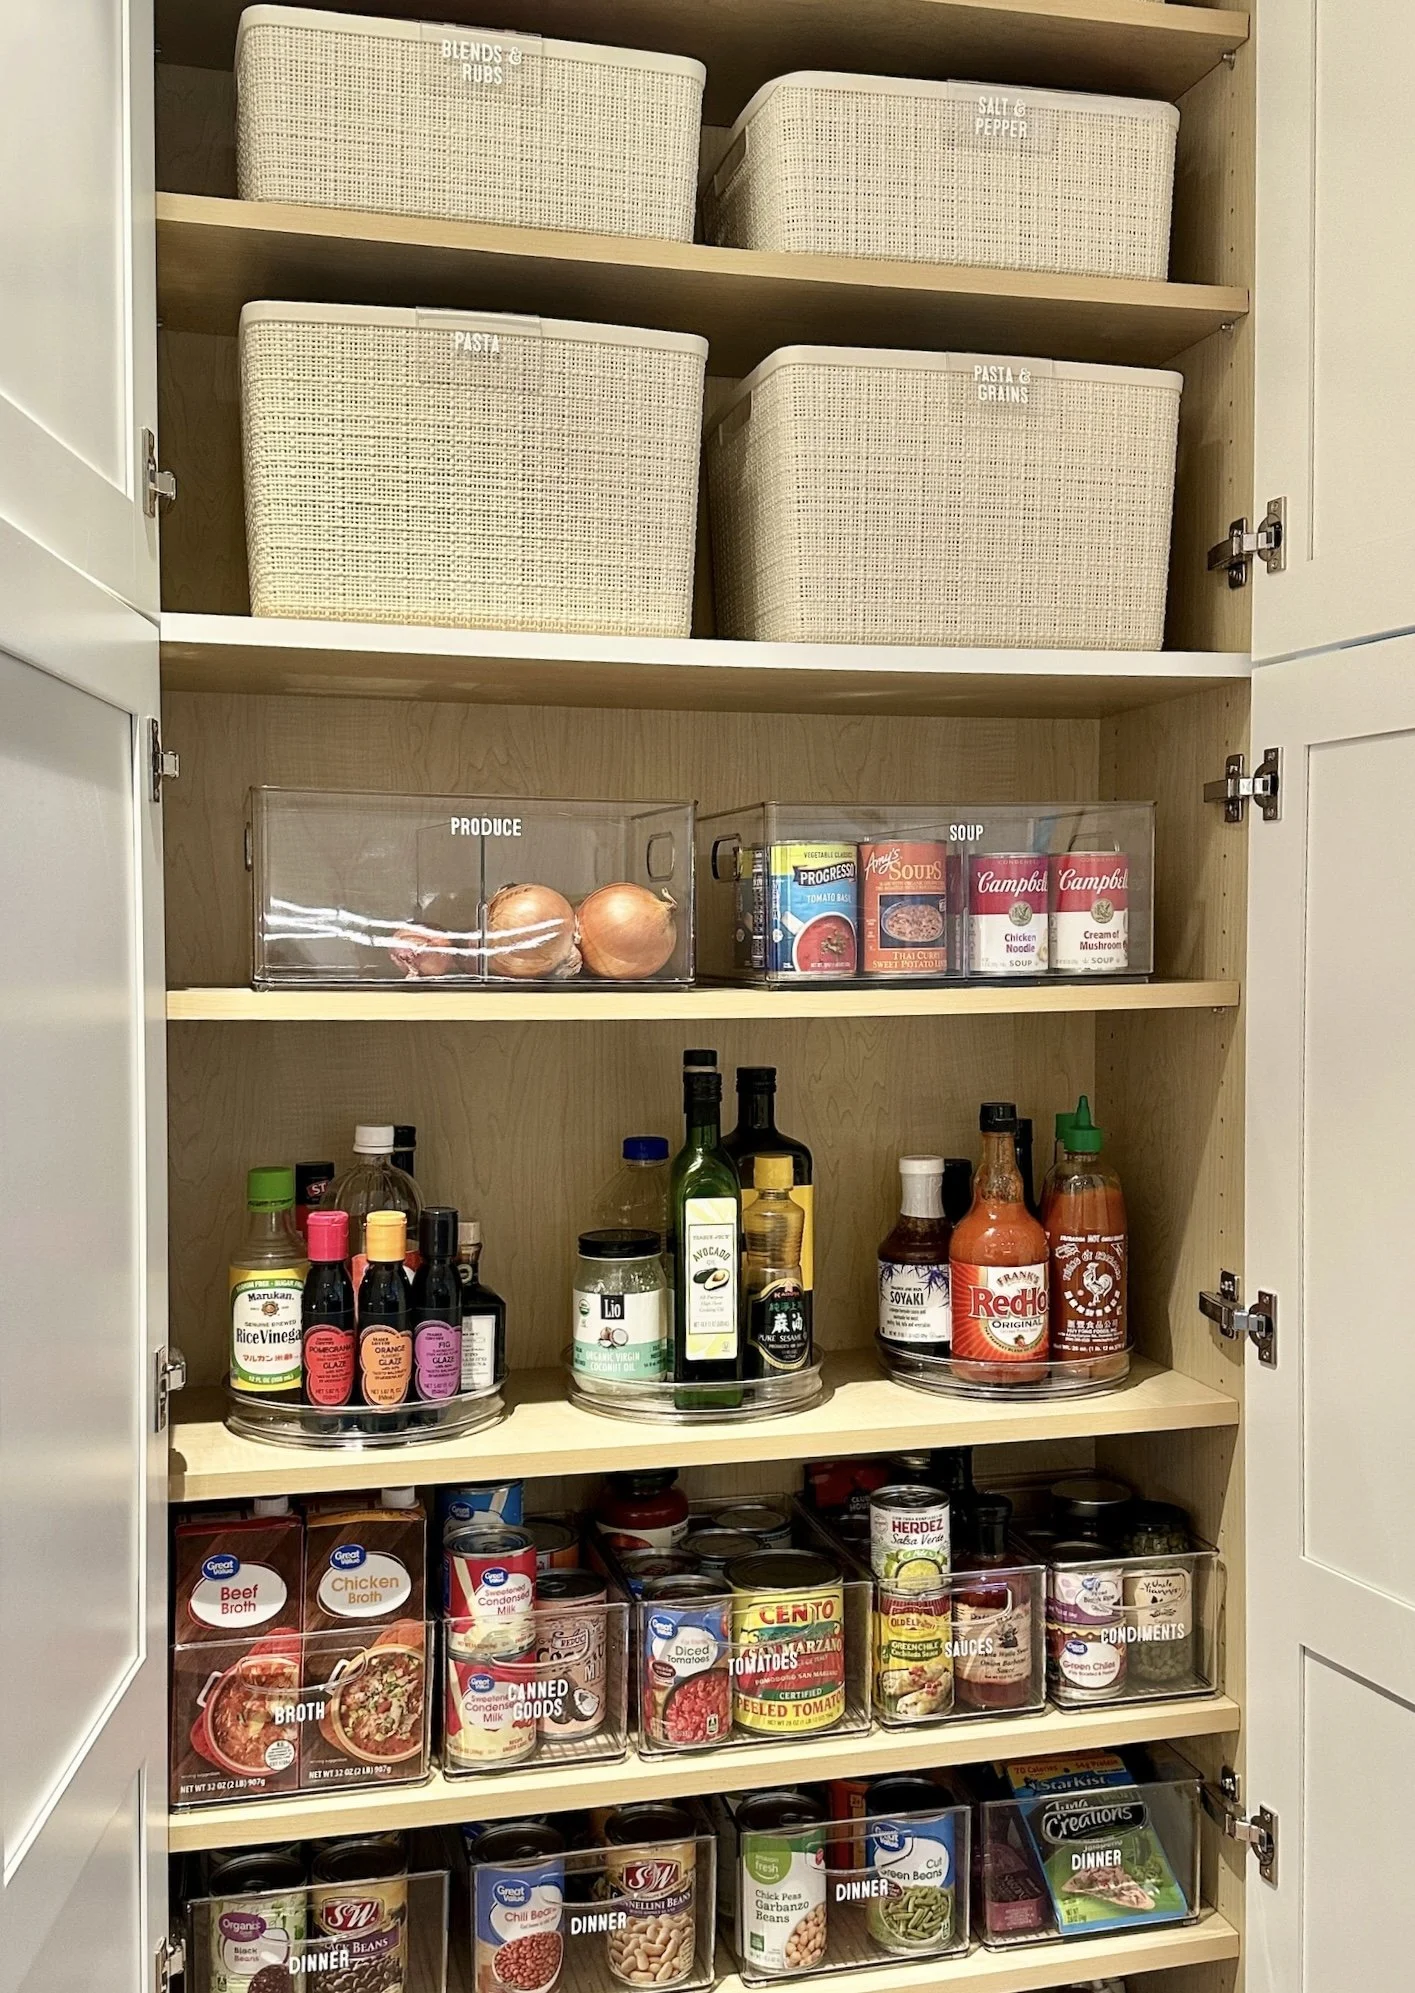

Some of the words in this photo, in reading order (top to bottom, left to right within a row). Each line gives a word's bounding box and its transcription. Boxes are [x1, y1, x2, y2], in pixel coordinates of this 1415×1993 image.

[442, 40, 503, 64] BLENDS
[509, 46, 522, 65] &
[462, 63, 503, 85] RUBS
[979, 96, 1008, 116] SALT
[1013, 98, 1027, 117] &
[975, 117, 1028, 138] PEPPER
[455, 331, 500, 353] PASTA
[974, 364, 1014, 383] PASTA
[1018, 367, 1031, 384] &
[977, 384, 1030, 404] GRAINS
[450, 817, 522, 837] PRODUCE
[949, 824, 984, 842] SOUP
[803, 851, 834, 859] VEGETABLE
[864, 848, 903, 881] Amy's
[888, 861, 943, 881] SOUPS
[800, 863, 856, 885] PROGRESSO
[806, 893, 836, 904] TOMATO
[1004, 932, 1037, 944] Chicken
[1083, 930, 1111, 943] Cream
[1112, 930, 1120, 941] of
[1005, 943, 1036, 954] Noodle
[1080, 941, 1122, 951] Mushroom
[873, 959, 899, 970] SWEET
[901, 958, 932, 969] POTATO
[892, 952, 915, 964] THAI
[1091, 957, 1114, 965] SOUP
[693, 1246, 731, 1262] AVOCADO
[997, 1271, 1040, 1287] FRANK'S
[890, 1291, 924, 1306] SOYAKI
[968, 1284, 1049, 1320] RedHo
[604, 1299, 621, 1318] Lio
[992, 1319, 1043, 1329] ORIGINAL
[236, 1328, 260, 1344] Rice
[375, 1345, 406, 1354] ORANGE
[586, 1351, 613, 1361] ORGANIC
[616, 1350, 641, 1360] VIRGIN
[323, 1360, 346, 1370] GLAZE
[379, 1357, 402, 1366] GLAZE
[433, 1356, 455, 1364] GLAZE
[591, 1361, 621, 1372] COCONUT
[623, 1361, 637, 1371] OIL
[892, 1518, 943, 1534] HERDEZ
[891, 1533, 918, 1545] Salsa
[335, 1550, 360, 1560] Great
[207, 1560, 233, 1571] Great
[331, 1574, 400, 1592] Chicken
[485, 1583, 526, 1597] Sweetened
[220, 1583, 259, 1601] Beef
[348, 1591, 383, 1606] Broth
[478, 1590, 530, 1607] Condensed
[220, 1600, 257, 1615] Broth
[497, 1605, 516, 1615] Milk
[758, 1600, 836, 1626] CENTO
[1101, 1622, 1185, 1644] CONDIMENTS
[675, 1645, 710, 1656] Diced
[782, 1638, 842, 1656] MARZANO
[891, 1641, 918, 1650] GREEN
[918, 1641, 939, 1649] CHILE
[944, 1638, 994, 1659] SAUCES
[667, 1655, 710, 1664] Tomatoes
[728, 1651, 799, 1677] TOMATOES
[1062, 1660, 1090, 1670] Green
[508, 1679, 570, 1702] CANNED
[779, 1688, 822, 1700] CERTIFIED
[274, 1701, 325, 1726] BROTH
[512, 1698, 563, 1721] GOODS
[736, 1695, 787, 1718] PEELED
[482, 1713, 503, 1723] Milk
[309, 1769, 323, 1779] NET
[322, 1768, 334, 1778] WT
[334, 1768, 344, 1777] 32
[344, 1767, 354, 1776] OZ
[1014, 1765, 1026, 1774] 70
[1027, 1763, 1059, 1773] Calories
[180, 1784, 194, 1794] NET
[195, 1783, 206, 1793] WT
[206, 1783, 216, 1791] 32
[217, 1781, 226, 1790] OZ
[1041, 1775, 1106, 1790] StarKist
[1045, 1799, 1088, 1812] Tuna
[1047, 1806, 1132, 1840] Creations
[926, 1857, 942, 1869] Cut
[1071, 1849, 1122, 1870] DINNER
[755, 1861, 779, 1873] fresh
[913, 1869, 943, 1880] Beans
[497, 1885, 525, 1896] Great
[755, 1889, 780, 1900] Chick
[782, 1892, 802, 1900] Peas
[836, 1878, 889, 1902] DINNER
[503, 1894, 525, 1902] Value
[670, 1891, 692, 1908] BEANS
[755, 1899, 810, 1913] Garbanzo
[504, 1911, 528, 1923] Chili
[571, 1911, 627, 1936] DINNER
[755, 1910, 790, 1923] Beans
[352, 1939, 389, 1954] BEANS
[234, 1954, 261, 1962] Beans
[288, 1949, 350, 1974] DINNER
